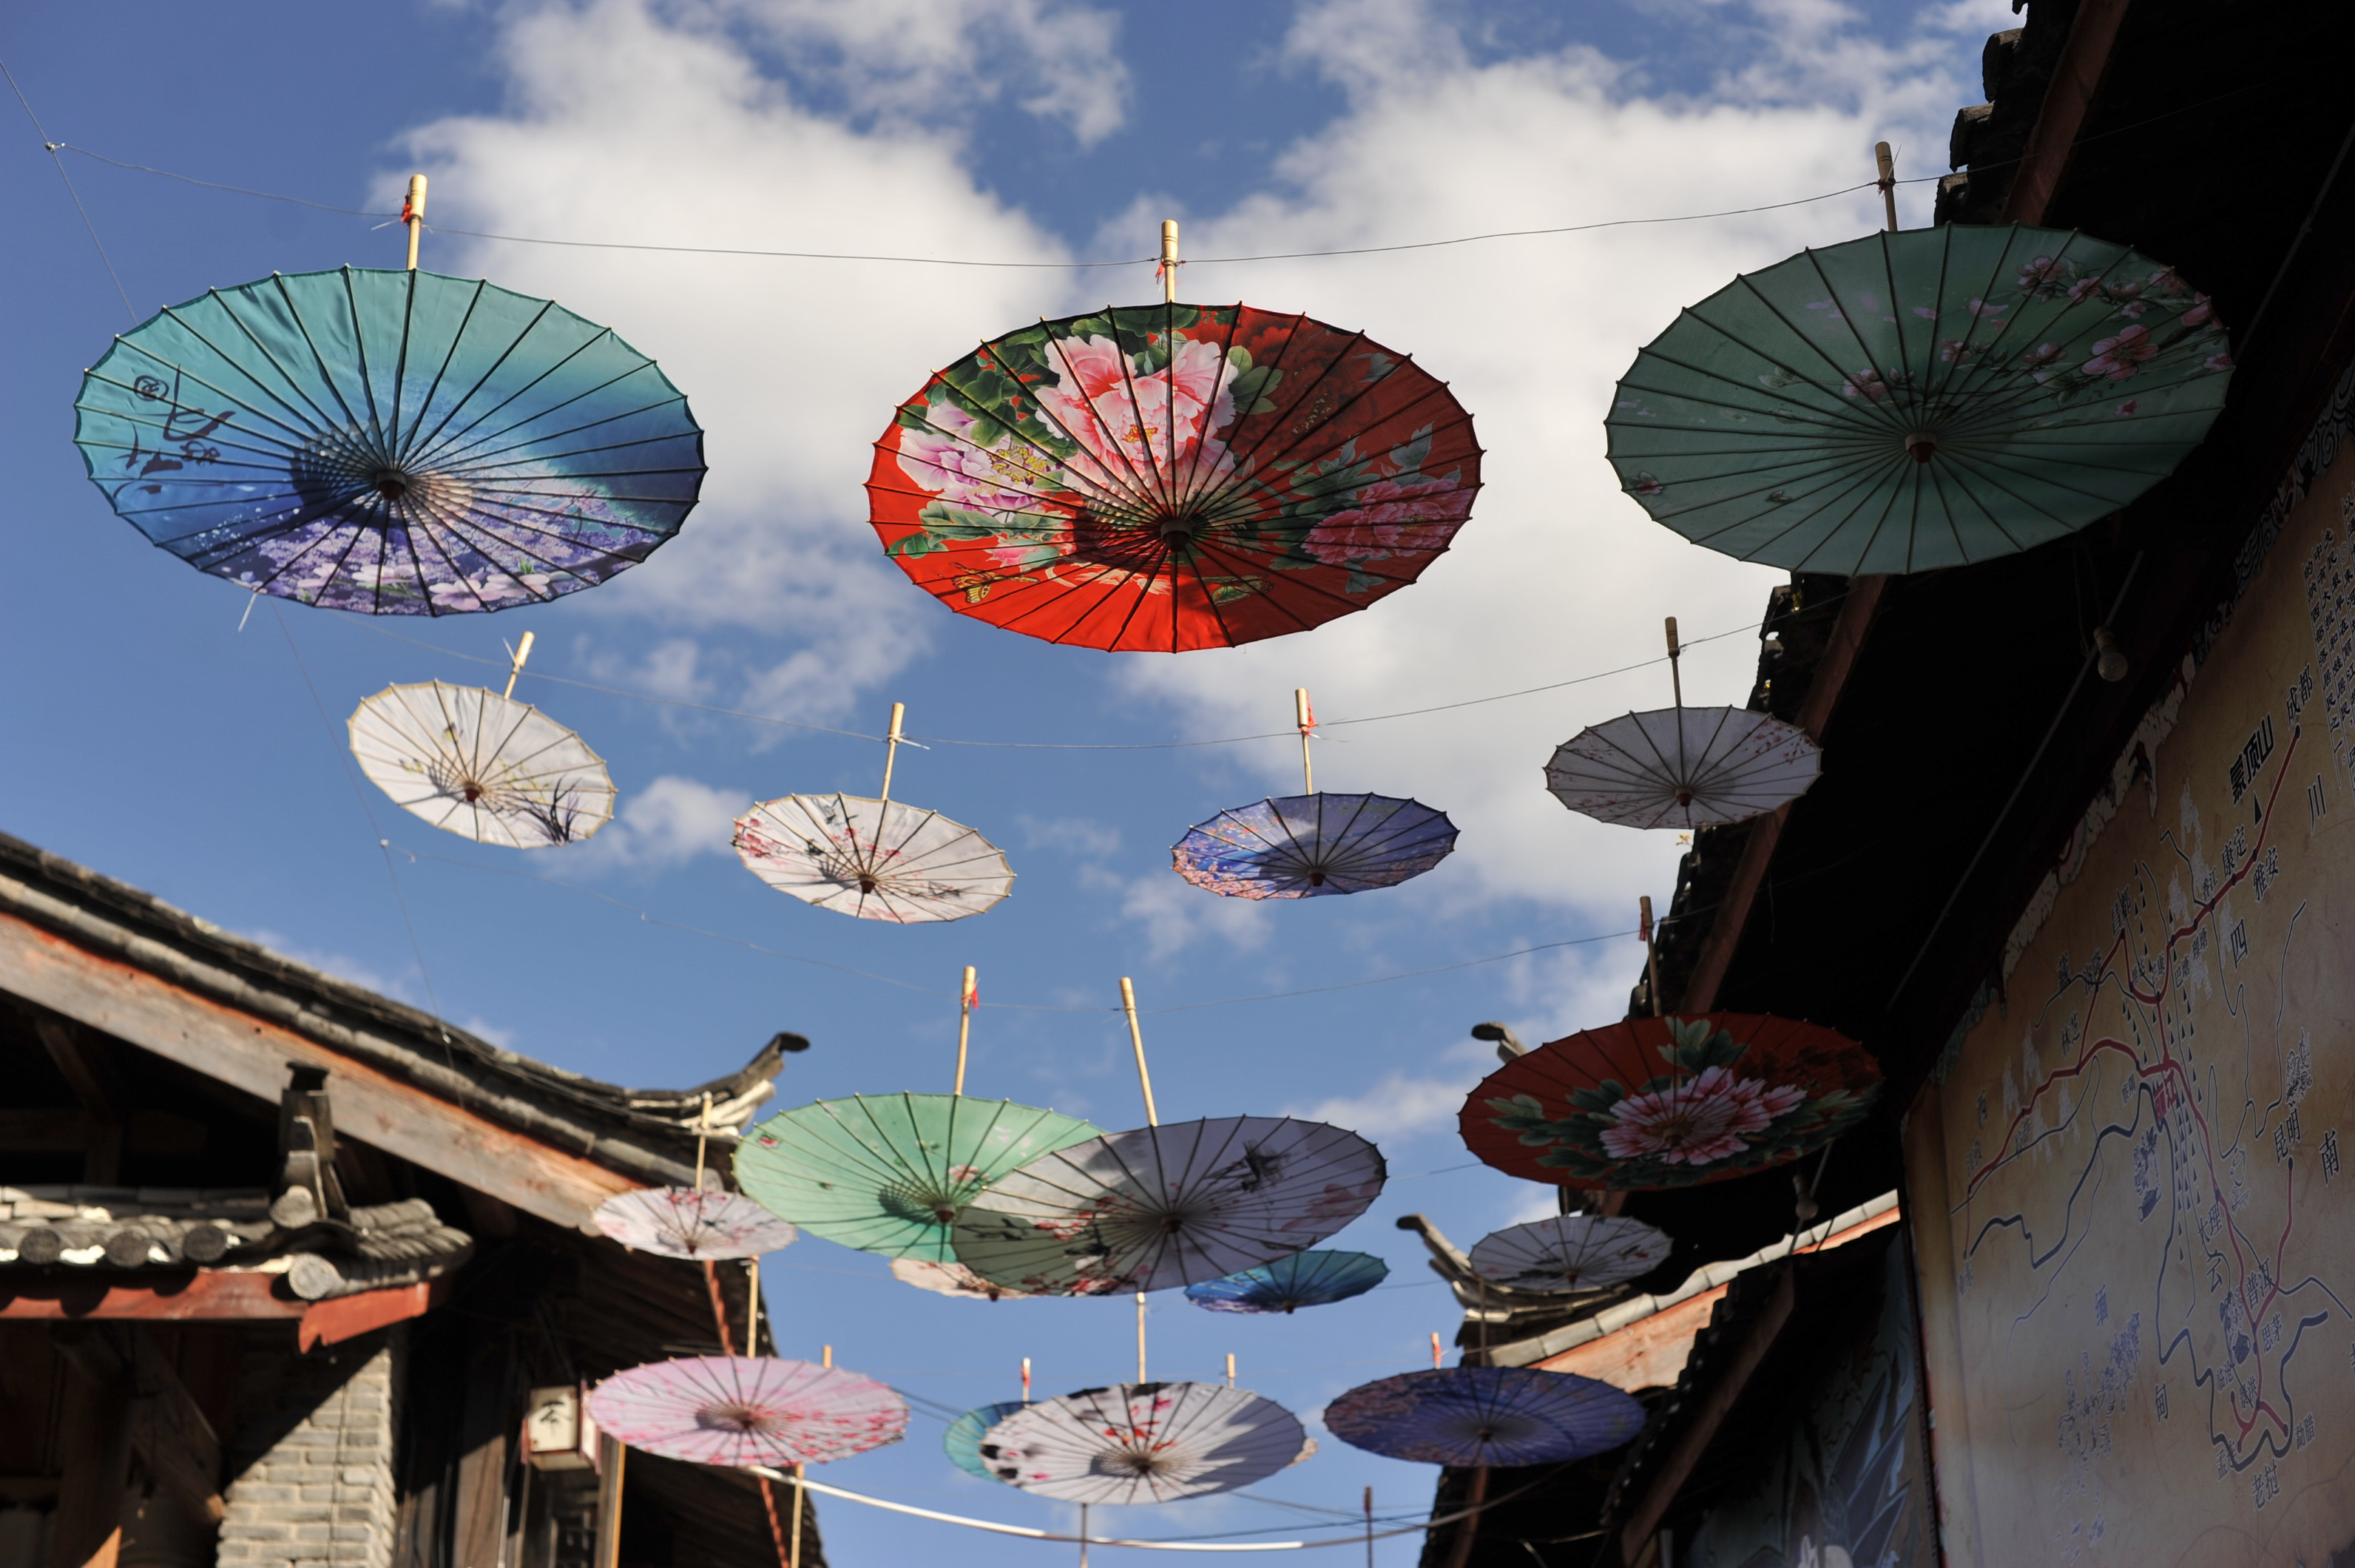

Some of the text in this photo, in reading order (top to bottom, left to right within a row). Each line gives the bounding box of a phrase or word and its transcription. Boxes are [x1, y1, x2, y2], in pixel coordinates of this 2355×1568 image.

[2287, 665, 2312, 724] 成都
[2230, 714, 2274, 805] 蒙顶山
[2308, 774, 2326, 832] 川
[2222, 826, 2248, 878] 康定
[2253, 847, 2279, 901] 雅安
[2231, 920, 2248, 969] 四
[2061, 1013, 2080, 1053] 林芝
[2274, 1109, 2301, 1164] 昆明
[2319, 1129, 2339, 1186] 南
[2198, 1203, 2222, 1252] 大理
[2207, 1249, 2222, 1293] 云
[2246, 1258, 2272, 1309] 普洱
[2263, 1314, 2283, 1353] 思茅
[2155, 1383, 2169, 1422] 甸
[2294, 1414, 2315, 1450] 勐腊
[2251, 1459, 2280, 1509] 老挝
